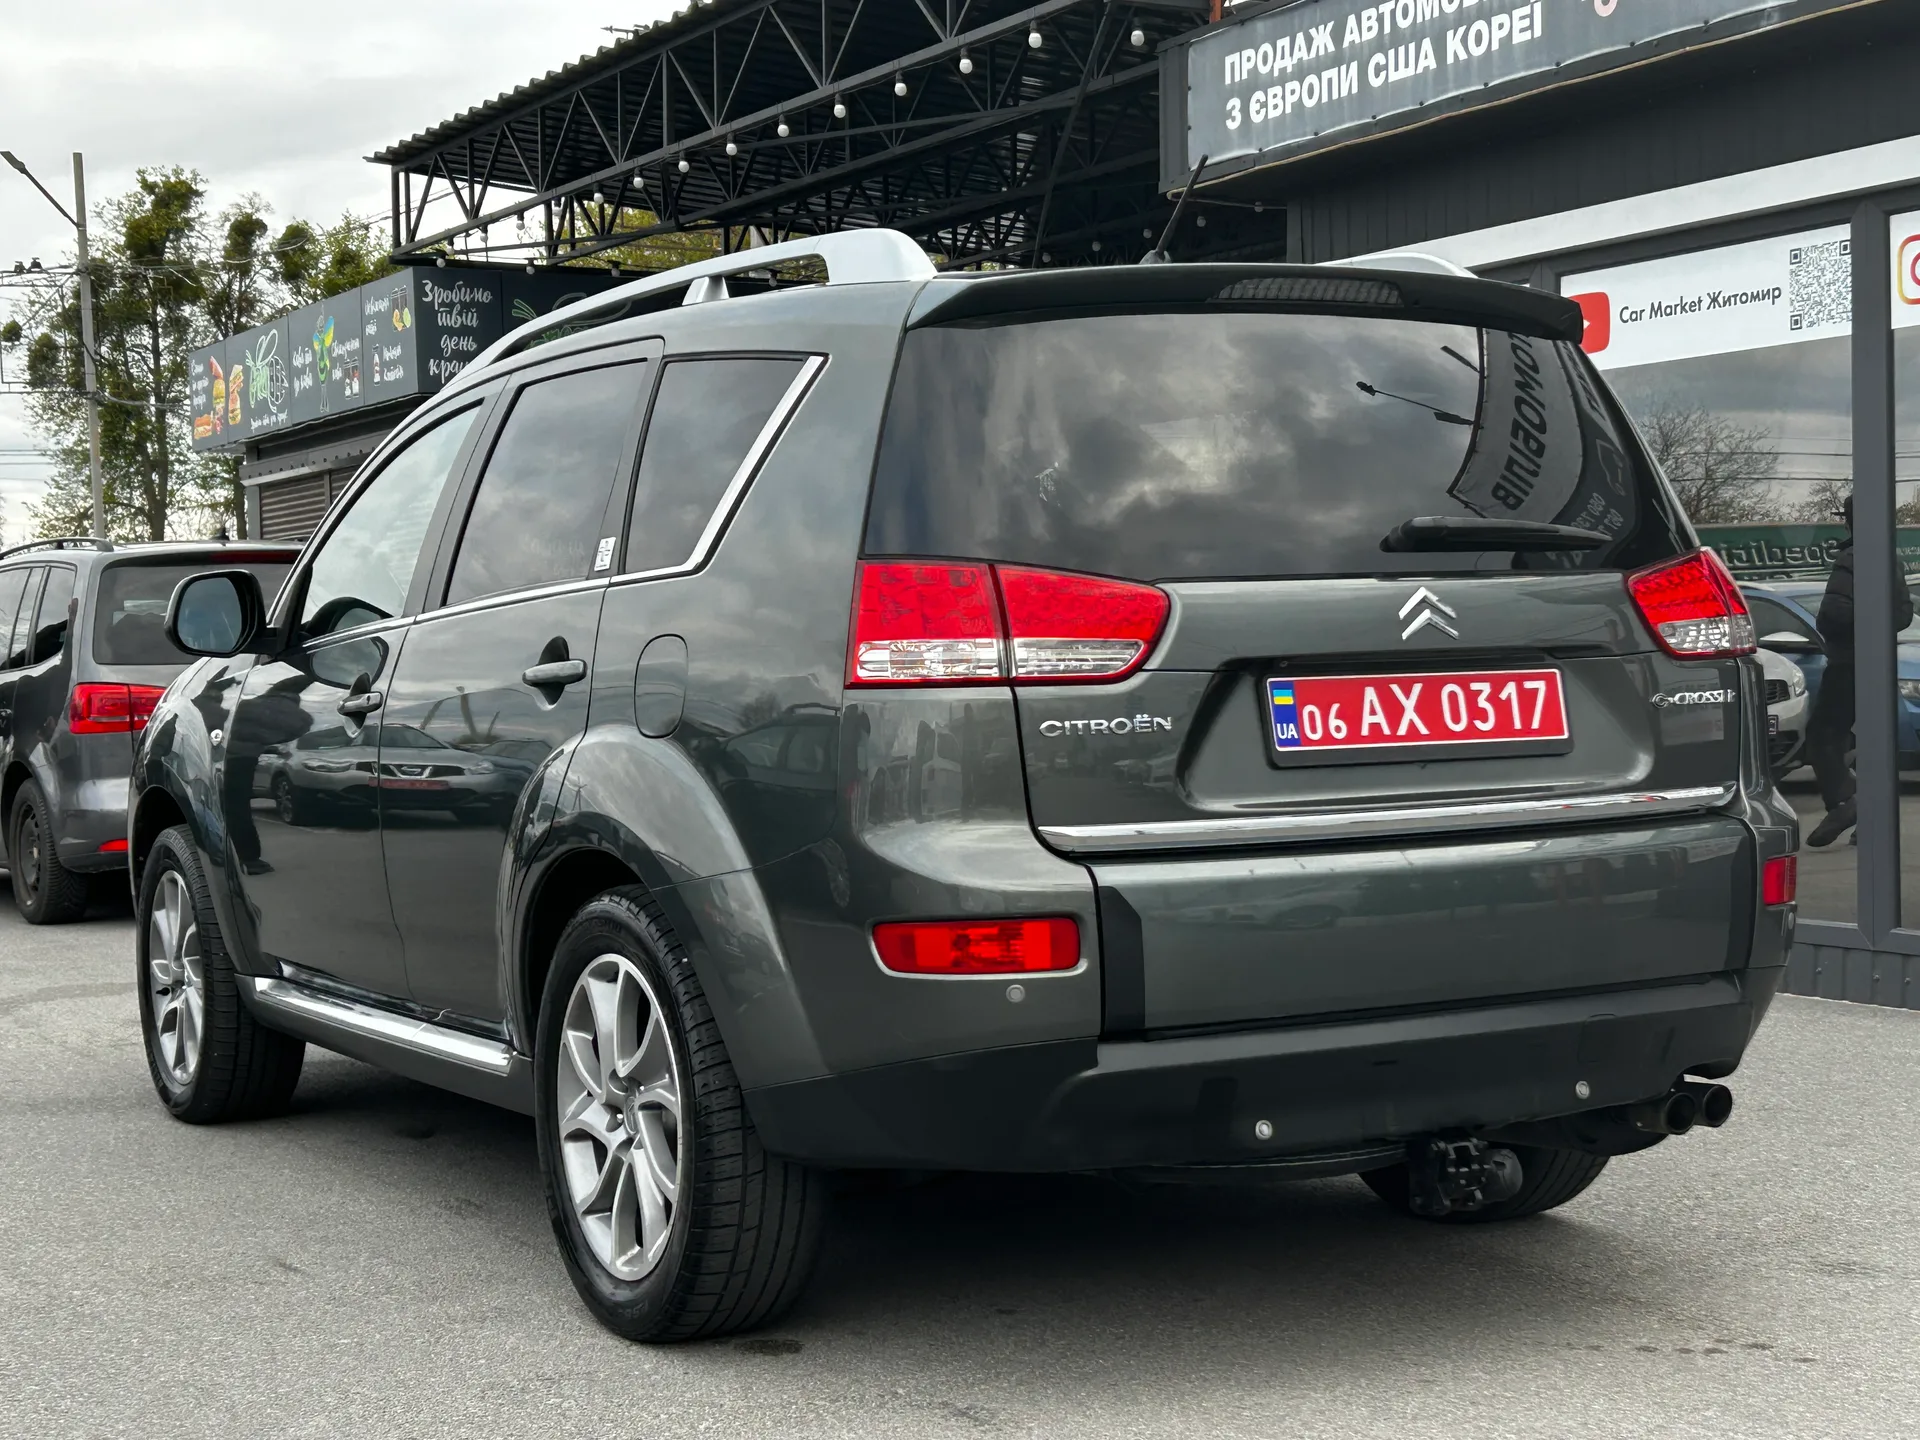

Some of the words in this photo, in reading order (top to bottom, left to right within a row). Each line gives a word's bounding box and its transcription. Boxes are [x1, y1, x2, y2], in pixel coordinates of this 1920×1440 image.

[1225, 21, 1336, 85] ПРОДАЖ
[1342, 0, 1485, 48] АВТОМ
[1225, 97, 1242, 130] З
[1249, 60, 1359, 123] ЄВРОПИ
[1367, 37, 1437, 88] США
[422, 280, 493, 310] Зробимо
[1619, 306, 1645, 324] Car
[1649, 296, 1703, 320] Market
[1706, 286, 1782, 310] Житомир
[438, 303, 478, 328] твій
[441, 334, 477, 357] день
[428, 358, 469, 384] кра
[1039, 713, 1173, 738] CITROËN
[1277, 723, 1298, 740] UA
[1302, 703, 1348, 741] 06
[1360, 683, 1431, 736] AX
[1440, 680, 1547, 732] 0317
